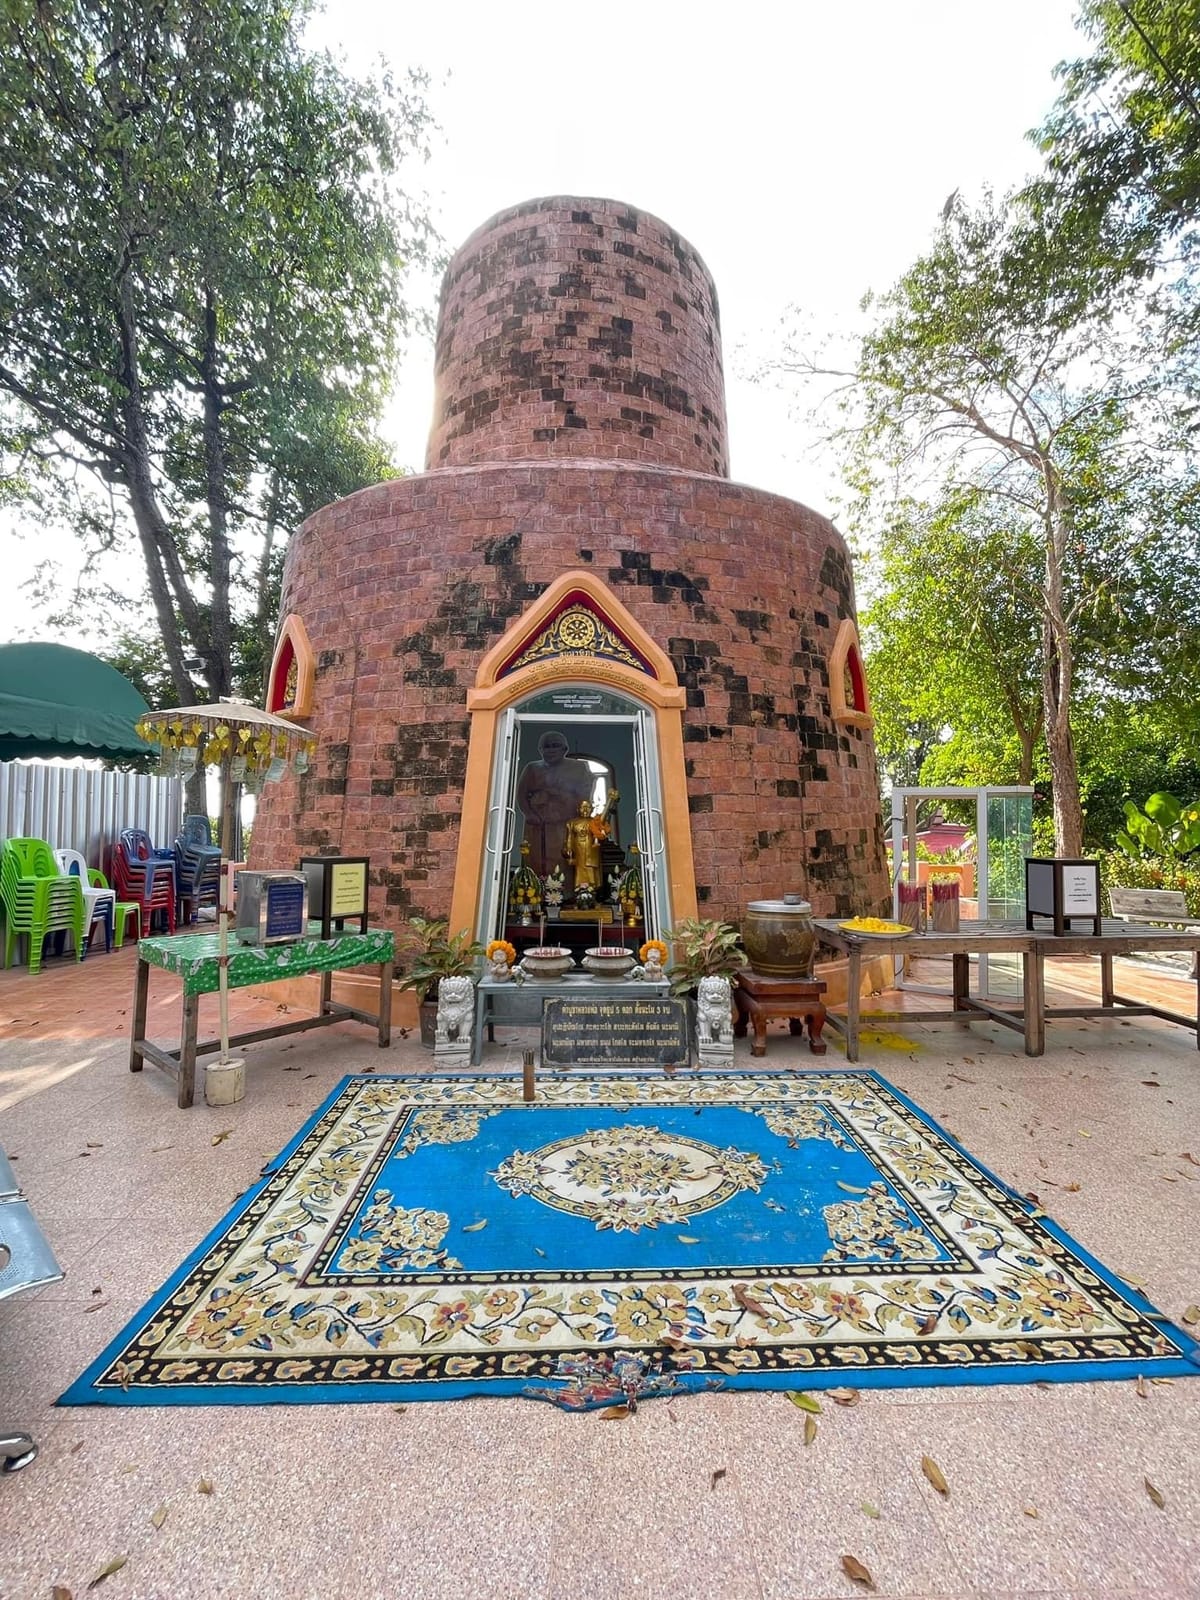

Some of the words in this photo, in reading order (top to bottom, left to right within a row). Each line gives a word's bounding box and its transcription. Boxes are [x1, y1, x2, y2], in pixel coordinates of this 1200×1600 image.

[615, 1006, 620, 1014] 5
[621, 1006, 633, 1014] ดอก
[656, 1006, 661, 1014] 3
